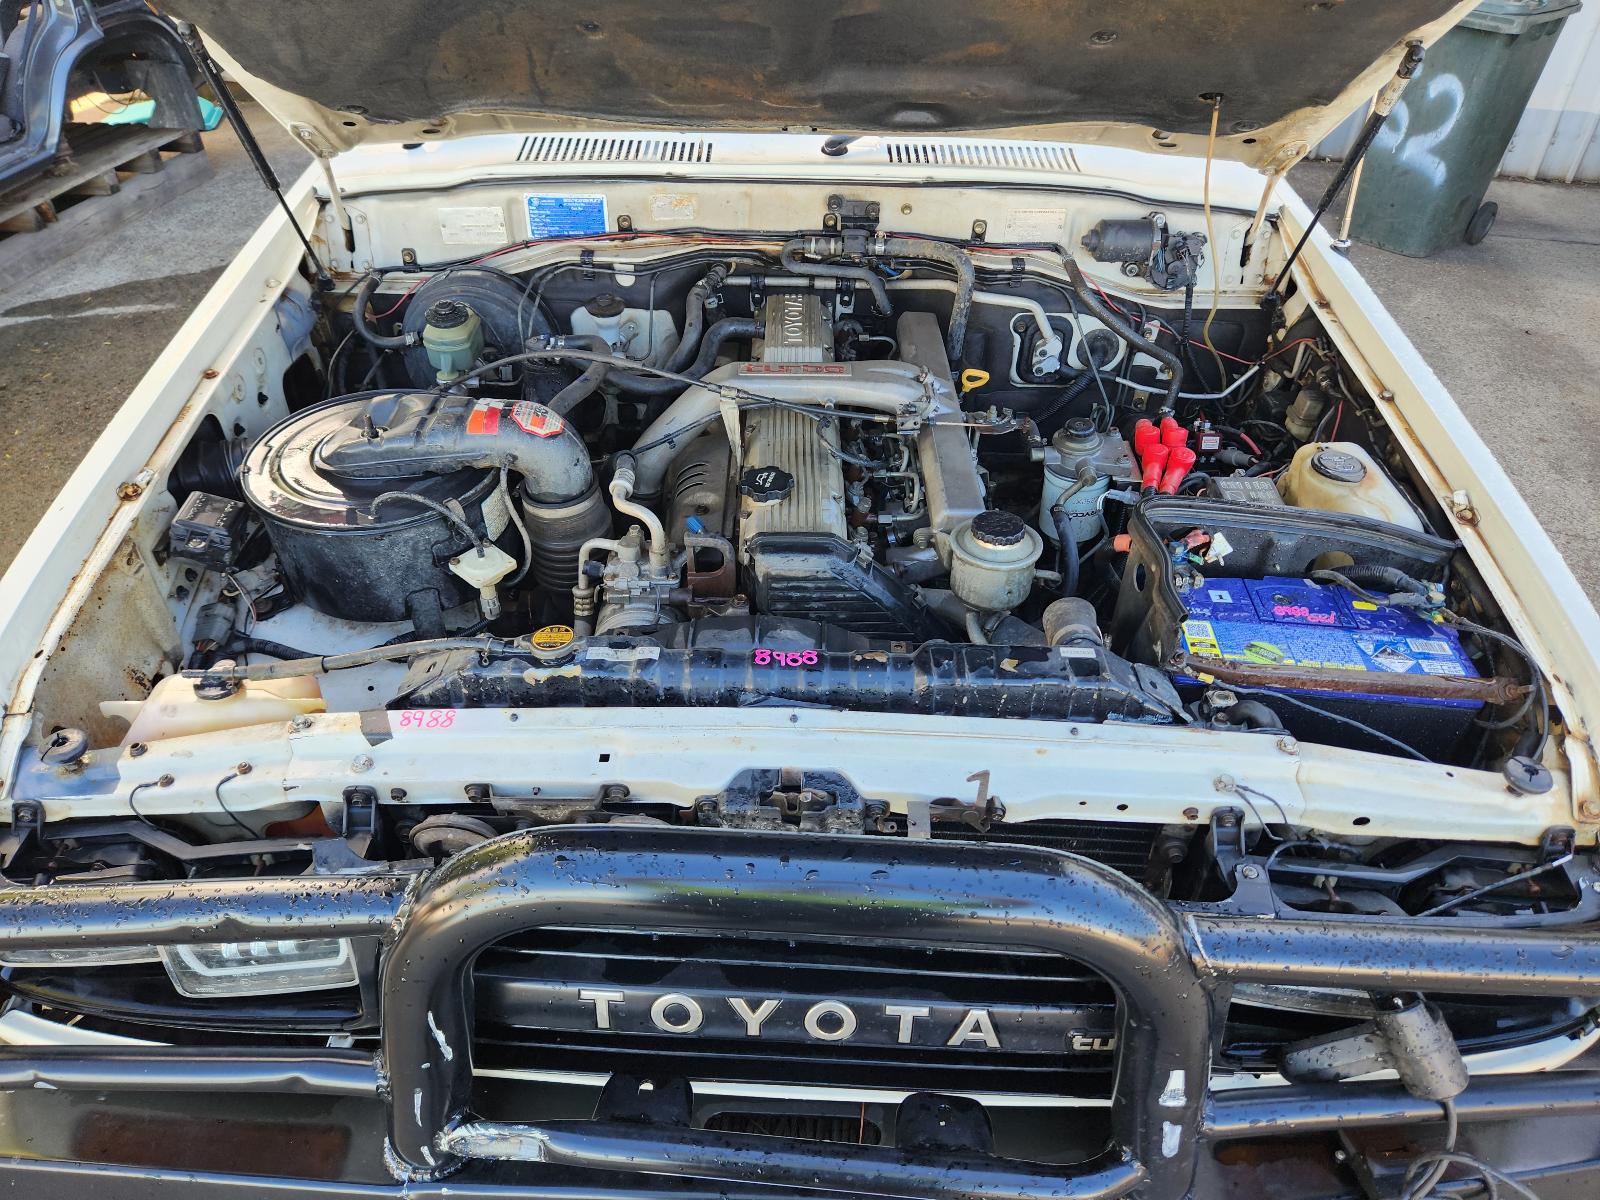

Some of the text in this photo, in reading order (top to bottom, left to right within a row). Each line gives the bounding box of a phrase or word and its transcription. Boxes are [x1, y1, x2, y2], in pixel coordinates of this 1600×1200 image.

[785, 294, 803, 344] TOYOTA
[754, 649, 818, 667] 8988
[400, 709, 457, 728] 8988
[577, 988, 1001, 1048] TOYOTA
